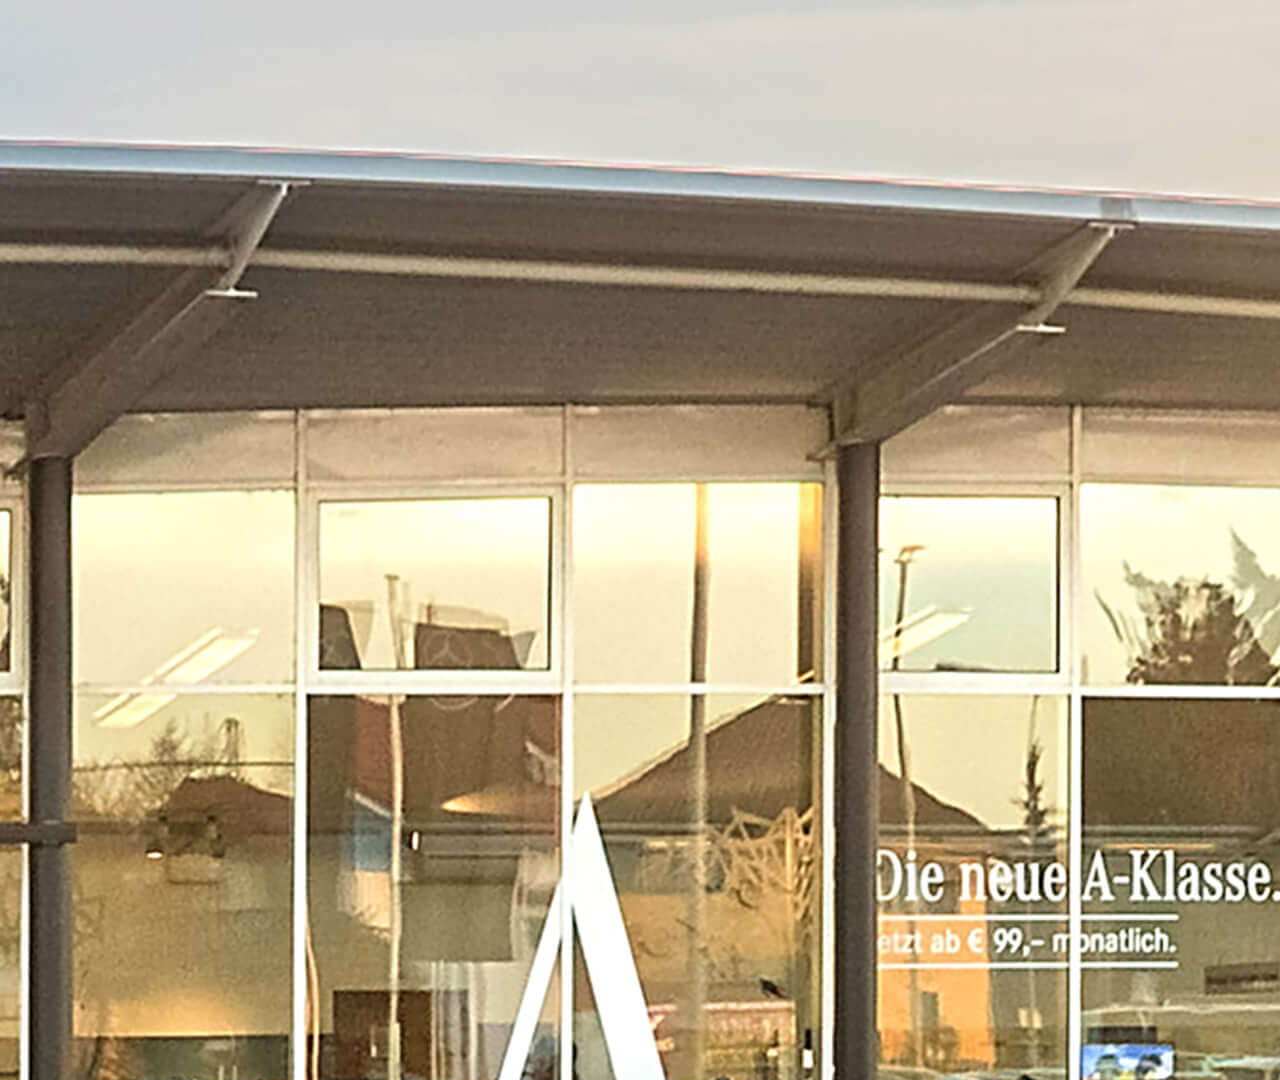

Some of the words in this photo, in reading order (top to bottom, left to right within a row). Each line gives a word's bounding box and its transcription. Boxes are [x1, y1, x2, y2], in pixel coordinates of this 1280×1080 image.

[877, 850, 944, 902] Die
[960, 860, 1068, 902] neue
[877, 928, 924, 954] etzt
[930, 927, 961, 954] ab
[967, 928, 985, 953] €
[1052, 926, 1177, 954] monatlich.
